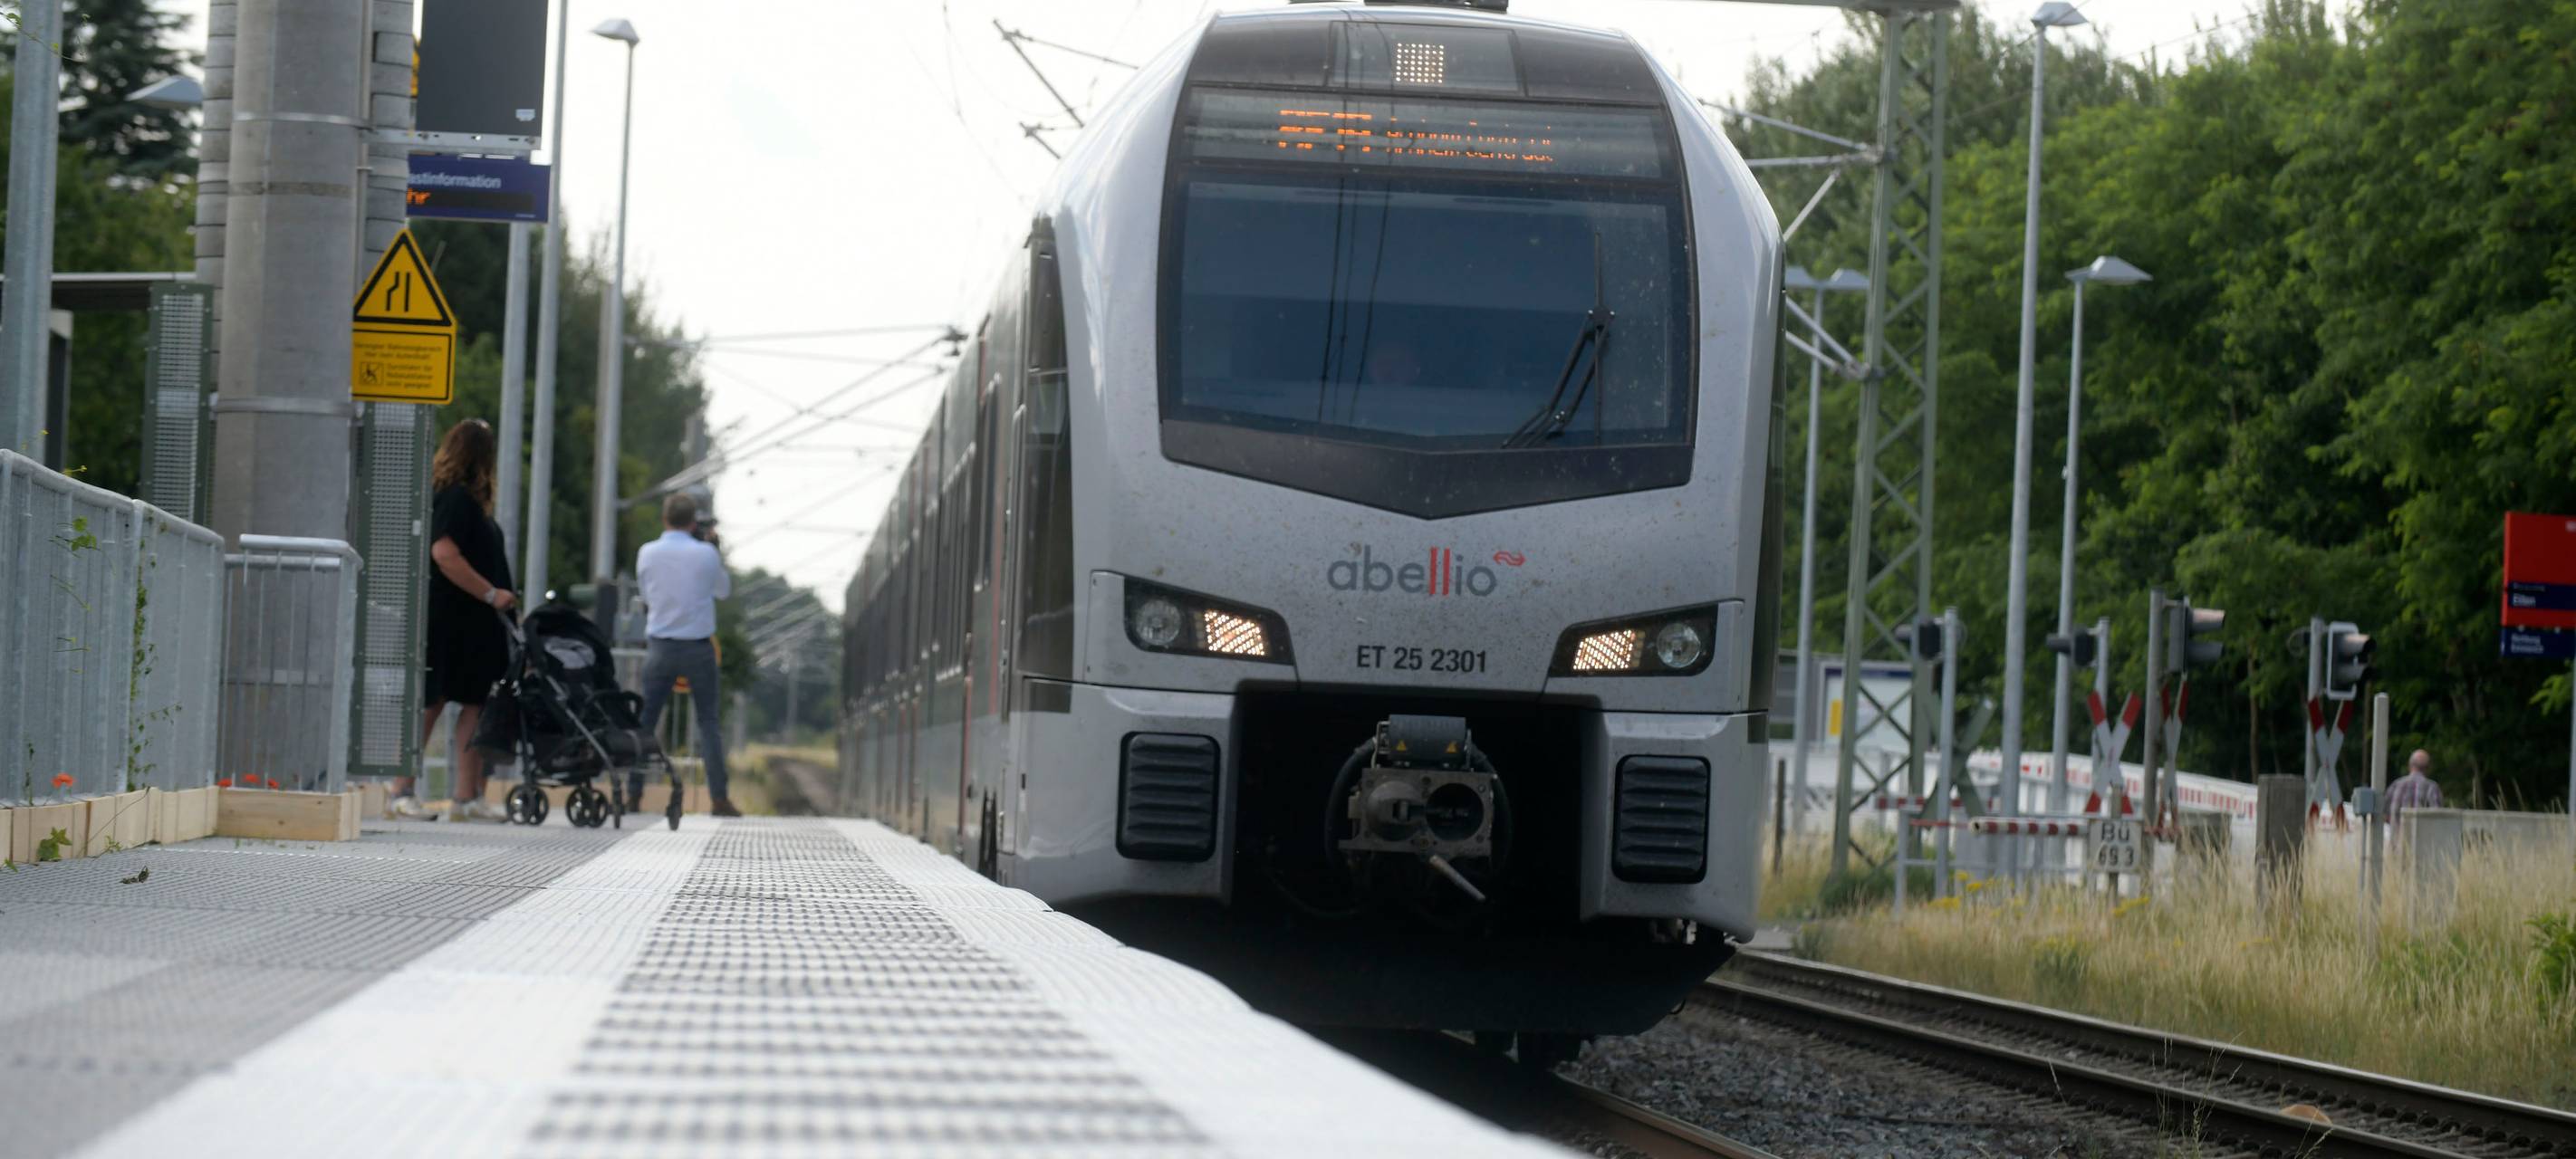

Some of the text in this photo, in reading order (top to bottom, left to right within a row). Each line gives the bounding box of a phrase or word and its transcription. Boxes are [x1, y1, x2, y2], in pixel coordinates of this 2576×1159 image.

[1327, 544, 1497, 598] abellio
[1357, 644, 1487, 673] ET 25 2301
